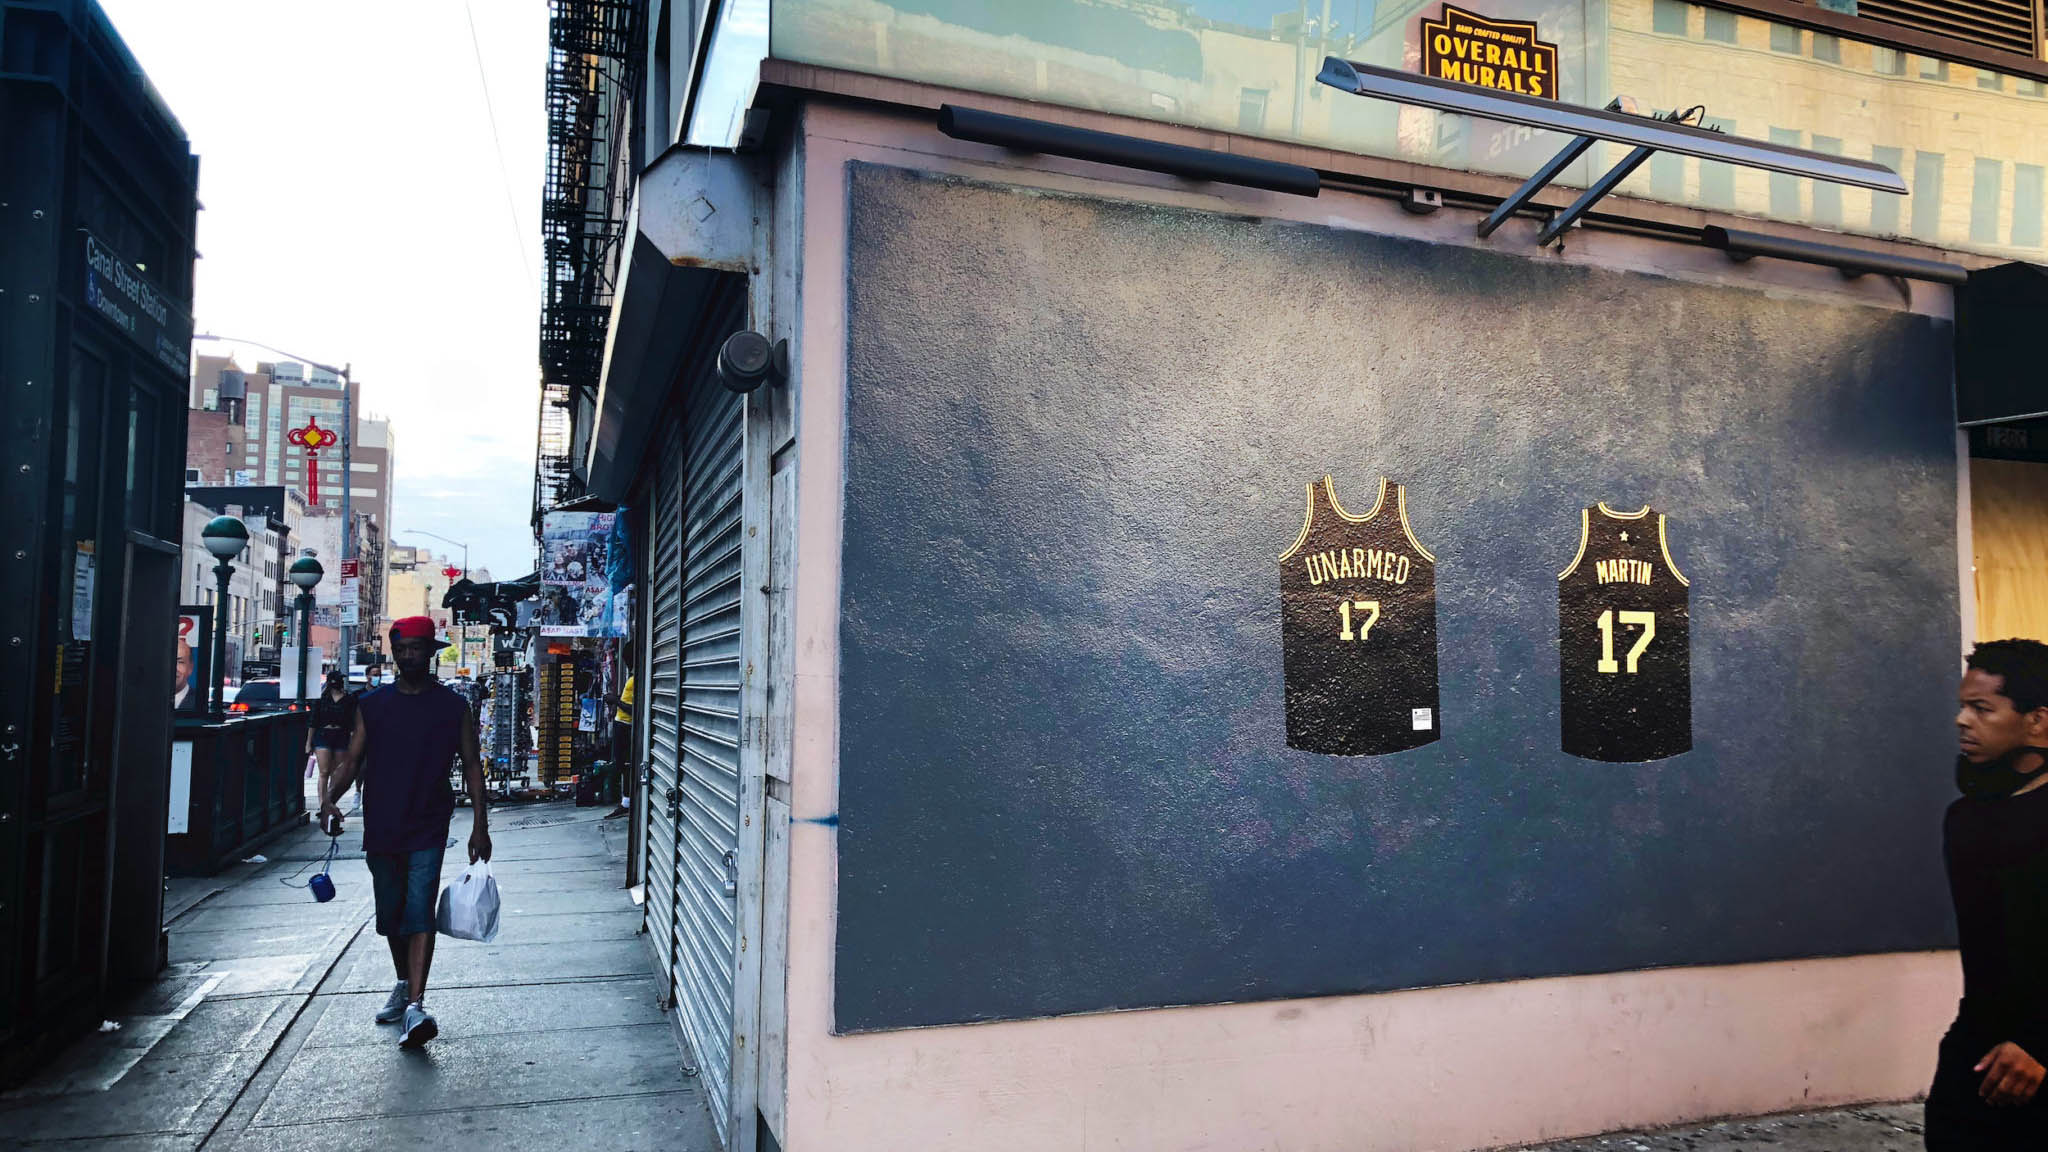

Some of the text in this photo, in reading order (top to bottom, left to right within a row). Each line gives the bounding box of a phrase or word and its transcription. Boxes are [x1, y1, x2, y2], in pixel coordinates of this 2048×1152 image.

[1434, 34, 1548, 75] OVERALL
[1455, 24, 1527, 45] HAND CRAFTED QUALITY
[1440, 58, 1543, 96] MURALS
[86, 236, 167, 328] Canal Street Station
[96, 287, 129, 328] Downtown
[1305, 547, 1409, 586] UNARMED
[1596, 559, 1653, 586] MARTIN
[1338, 601, 1381, 641] 17
[1597, 609, 1656, 673] 17
